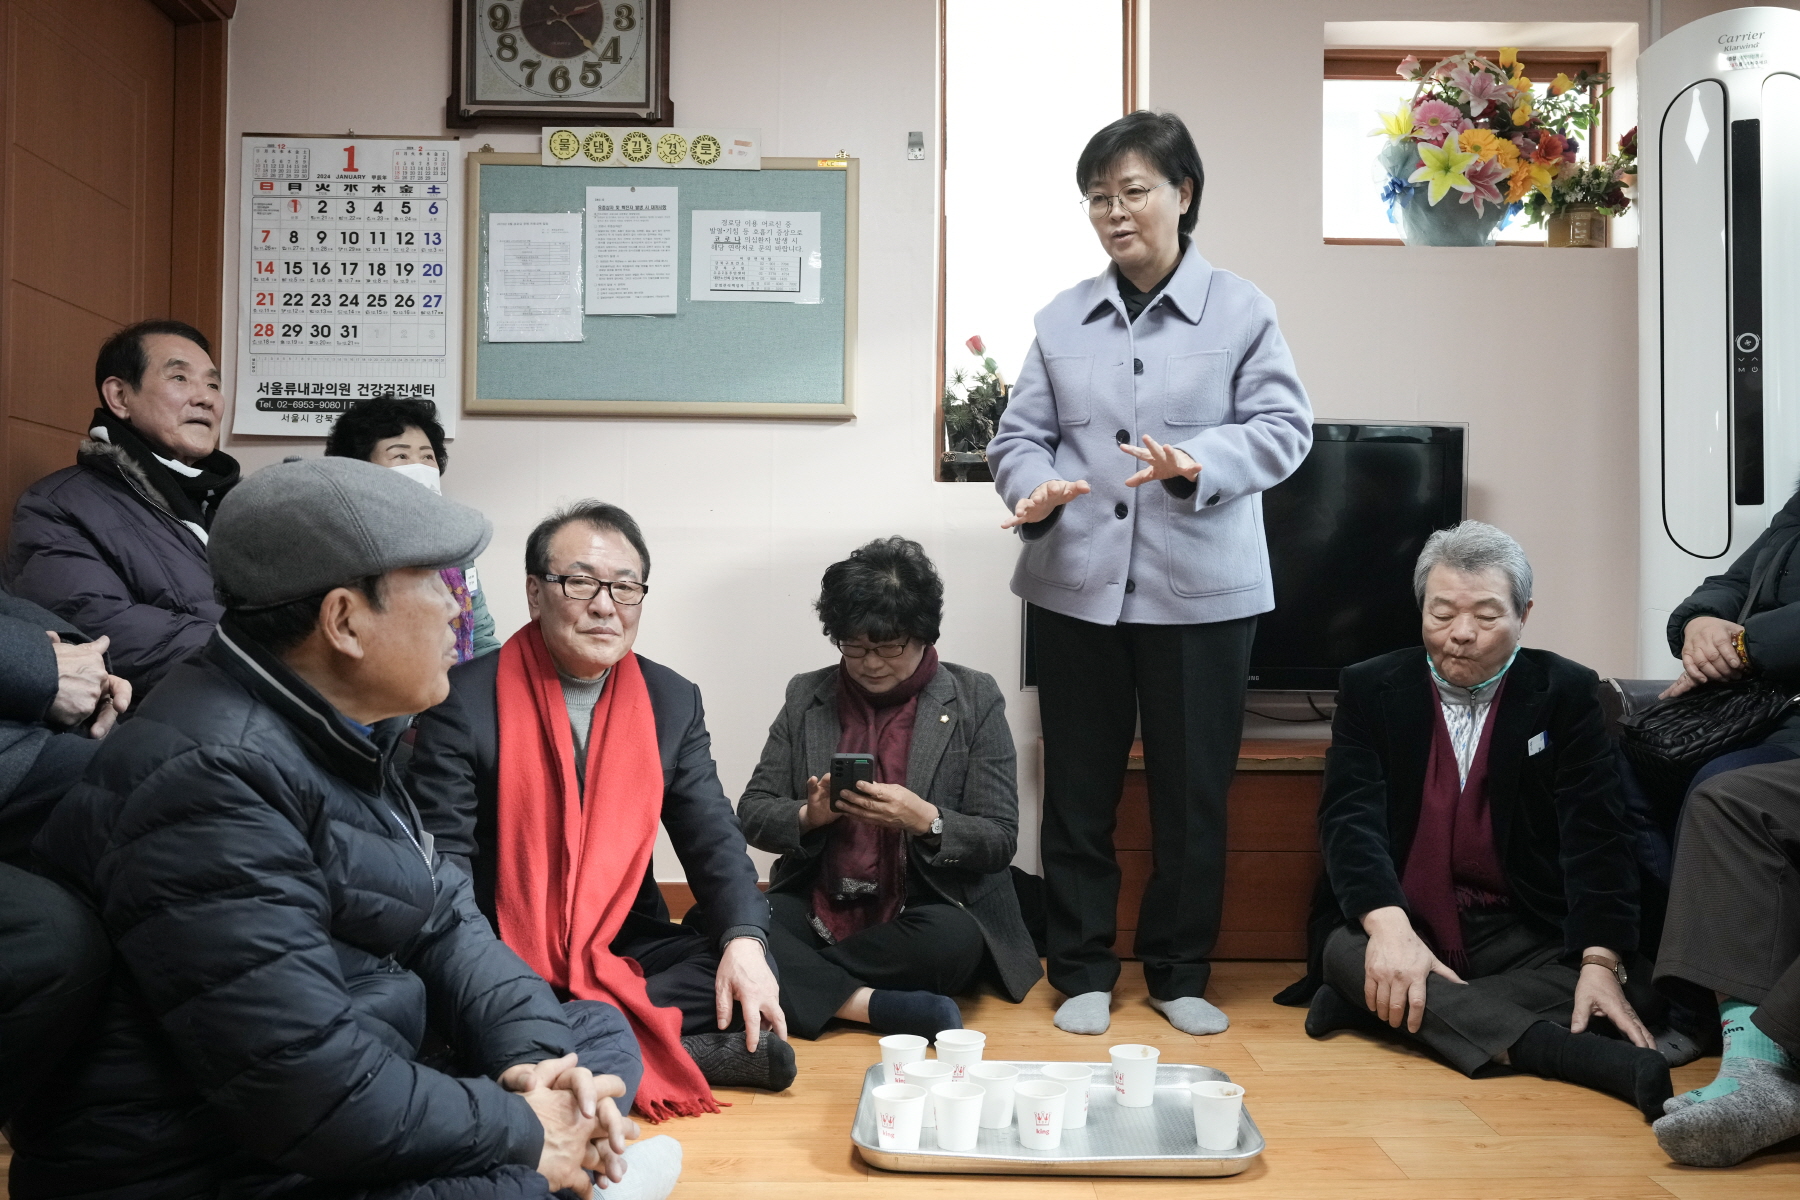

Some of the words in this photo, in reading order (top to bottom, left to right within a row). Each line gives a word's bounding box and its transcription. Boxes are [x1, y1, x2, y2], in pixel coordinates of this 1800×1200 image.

[487, 3, 511, 32] 9
[613, 3, 636, 31] 3
[1718, 32, 1765, 44] Carrier
[496, 33, 518, 62] 8
[598, 36, 622, 64] 4
[520, 59, 541, 88] 7
[548, 65, 571, 93] 6
[579, 61, 602, 88] 5
[343, 146, 359, 172] 1
[260, 182, 273, 190] 日
[288, 183, 302, 191] 月
[316, 183, 330, 192] 火
[344, 184, 358, 192] 水
[372, 184, 386, 193] 木
[400, 185, 413, 193] 金
[427, 185, 440, 193] 土
[291, 199, 298, 213] 1
[318, 200, 328, 213] 2
[346, 201, 356, 214] 3
[373, 201, 383, 214] 4
[401, 202, 411, 214] 5
[429, 202, 439, 215] 6
[762, 220, 782, 228] 어르신
[262, 230, 270, 242] 7
[289, 231, 299, 243] 8
[317, 231, 327, 244] 9
[341, 232, 359, 244] 10
[370, 232, 385, 244] 11
[397, 232, 414, 245] 12
[424, 232, 441, 245] 13
[753, 228, 773, 236] 호흡기
[256, 261, 274, 274] 14
[285, 262, 302, 274] 15
[313, 262, 330, 275] 16
[341, 263, 358, 275] 17
[369, 263, 386, 276] 18
[396, 263, 414, 276] 19
[423, 264, 442, 276] 20
[256, 293, 273, 305] 21
[283, 293, 303, 306] 22
[311, 294, 331, 306] 23
[339, 294, 359, 306] 24
[367, 294, 387, 307] 25
[395, 294, 414, 307] 26
[423, 295, 442, 307] 27
[254, 324, 274, 337] 28
[282, 324, 302, 337] 29
[310, 325, 331, 338] 30
[340, 325, 357, 338] 31
[257, 382, 351, 397] 서울류내과의원
[358, 383, 435, 398] 건강검진센터
[259, 400, 274, 409] Tel.
[277, 400, 341, 410] 02-6953-9080
[281, 413, 309, 424] 서울시
[882, 1130, 895, 1139] king
[1036, 1128, 1050, 1136] king
